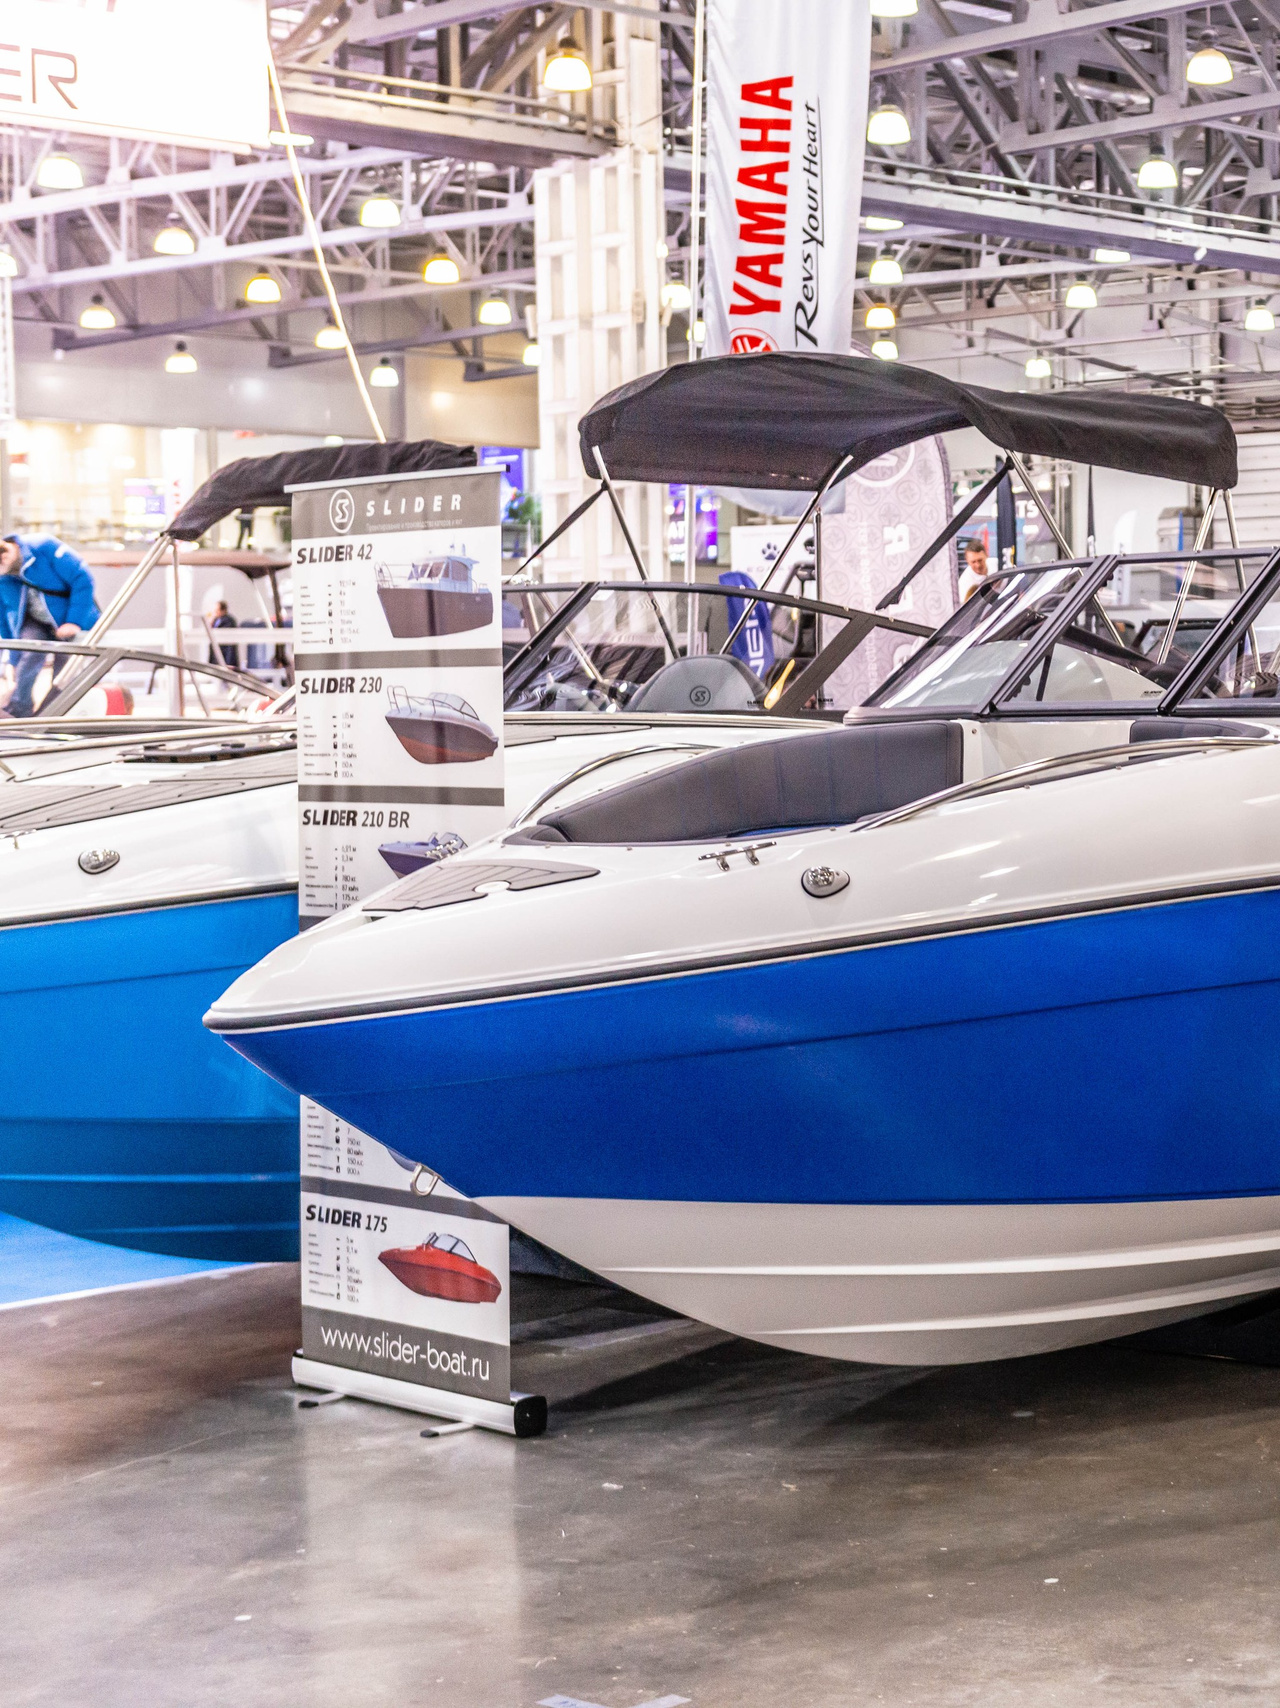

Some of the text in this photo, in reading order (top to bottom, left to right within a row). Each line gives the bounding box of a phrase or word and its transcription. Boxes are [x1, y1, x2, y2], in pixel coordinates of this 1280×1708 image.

[729, 76, 794, 315] YAMAHA
[795, 100, 824, 347] Revs Your Heart
[366, 493, 462, 517] SLIDER
[297, 543, 373, 564] SLIDER 42
[300, 676, 383, 694] SLIDER 230
[302, 809, 410, 828] SLIDER 210 BR
[305, 1204, 388, 1233] SLIDER 175
[321, 1326, 489, 1381] www.slider-boat.ru
